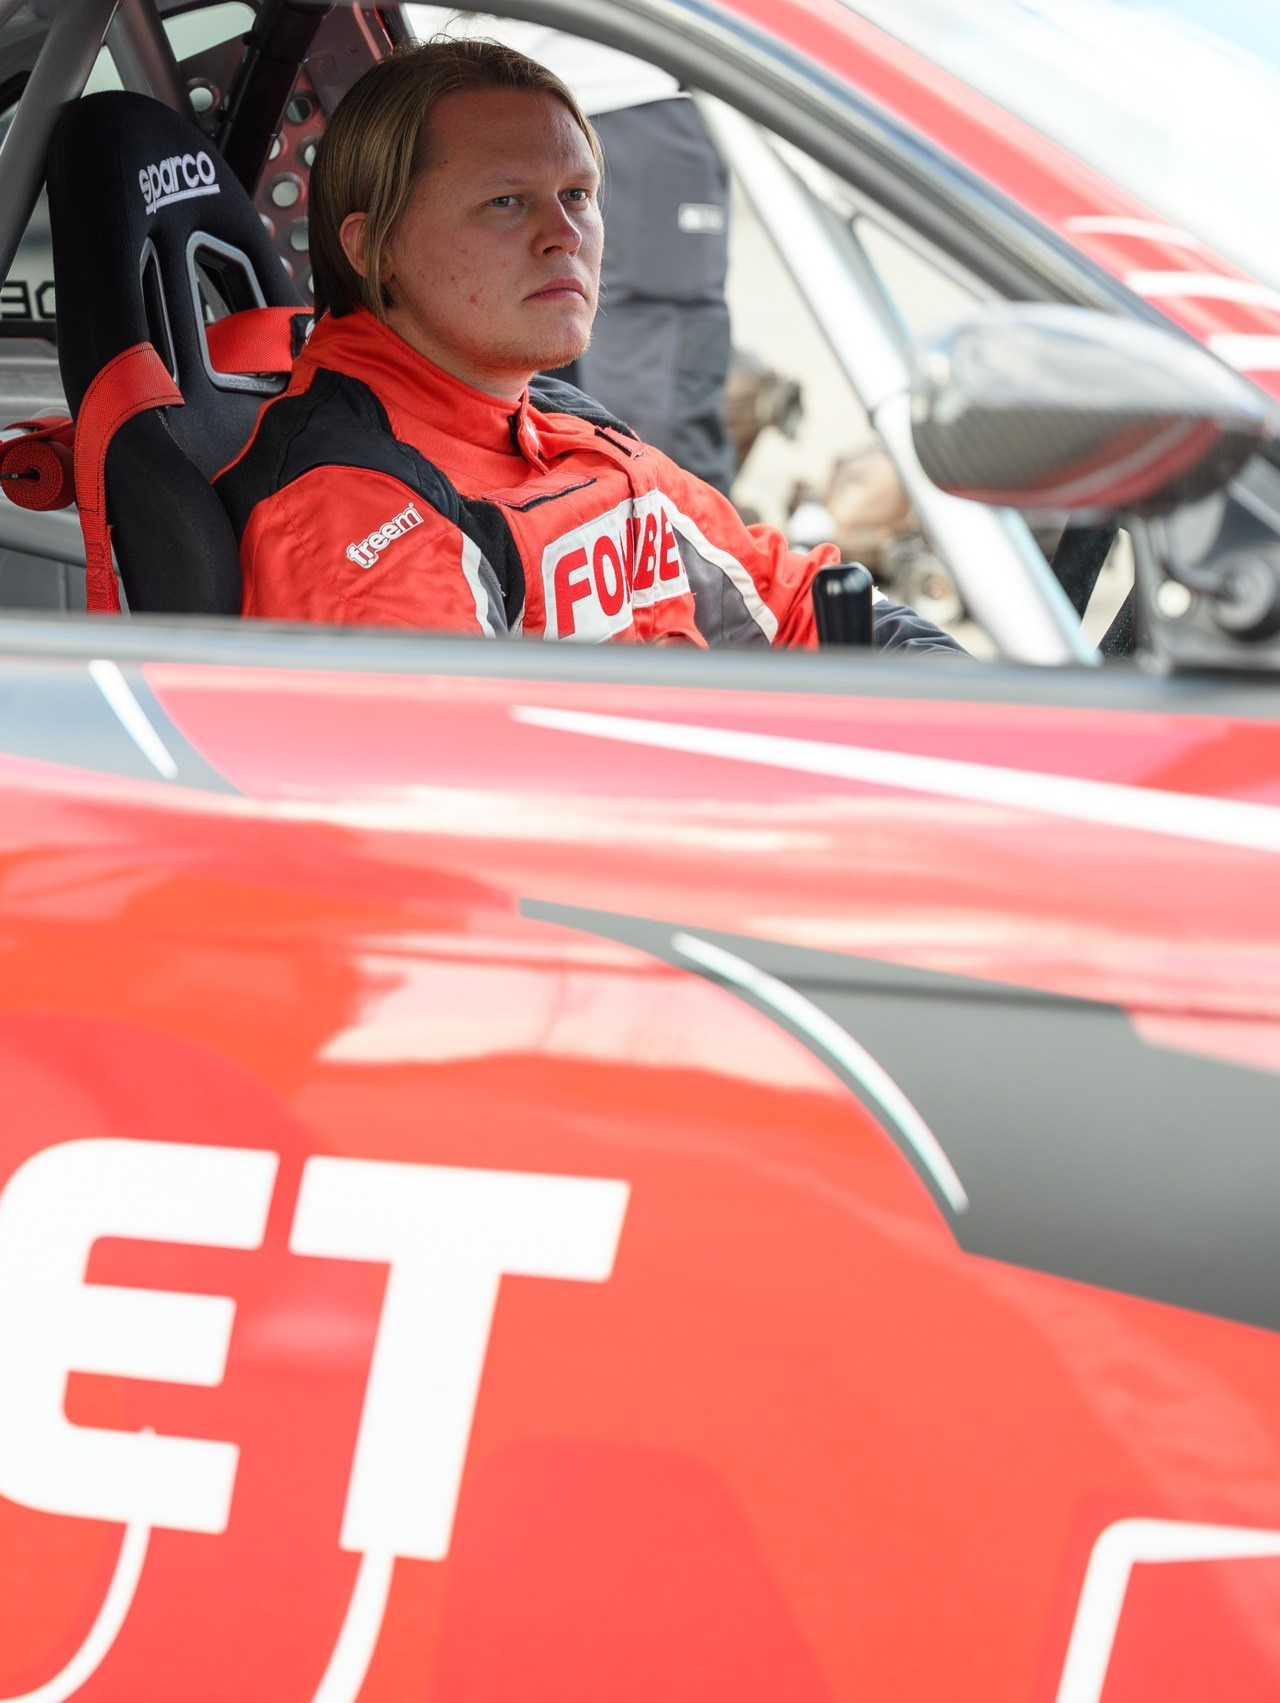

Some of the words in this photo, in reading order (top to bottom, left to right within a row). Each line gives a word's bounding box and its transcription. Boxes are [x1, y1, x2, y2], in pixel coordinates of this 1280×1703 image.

[138, 150, 217, 214] sparco
[346, 503, 424, 569] freem
[554, 506, 686, 640] FONBE
